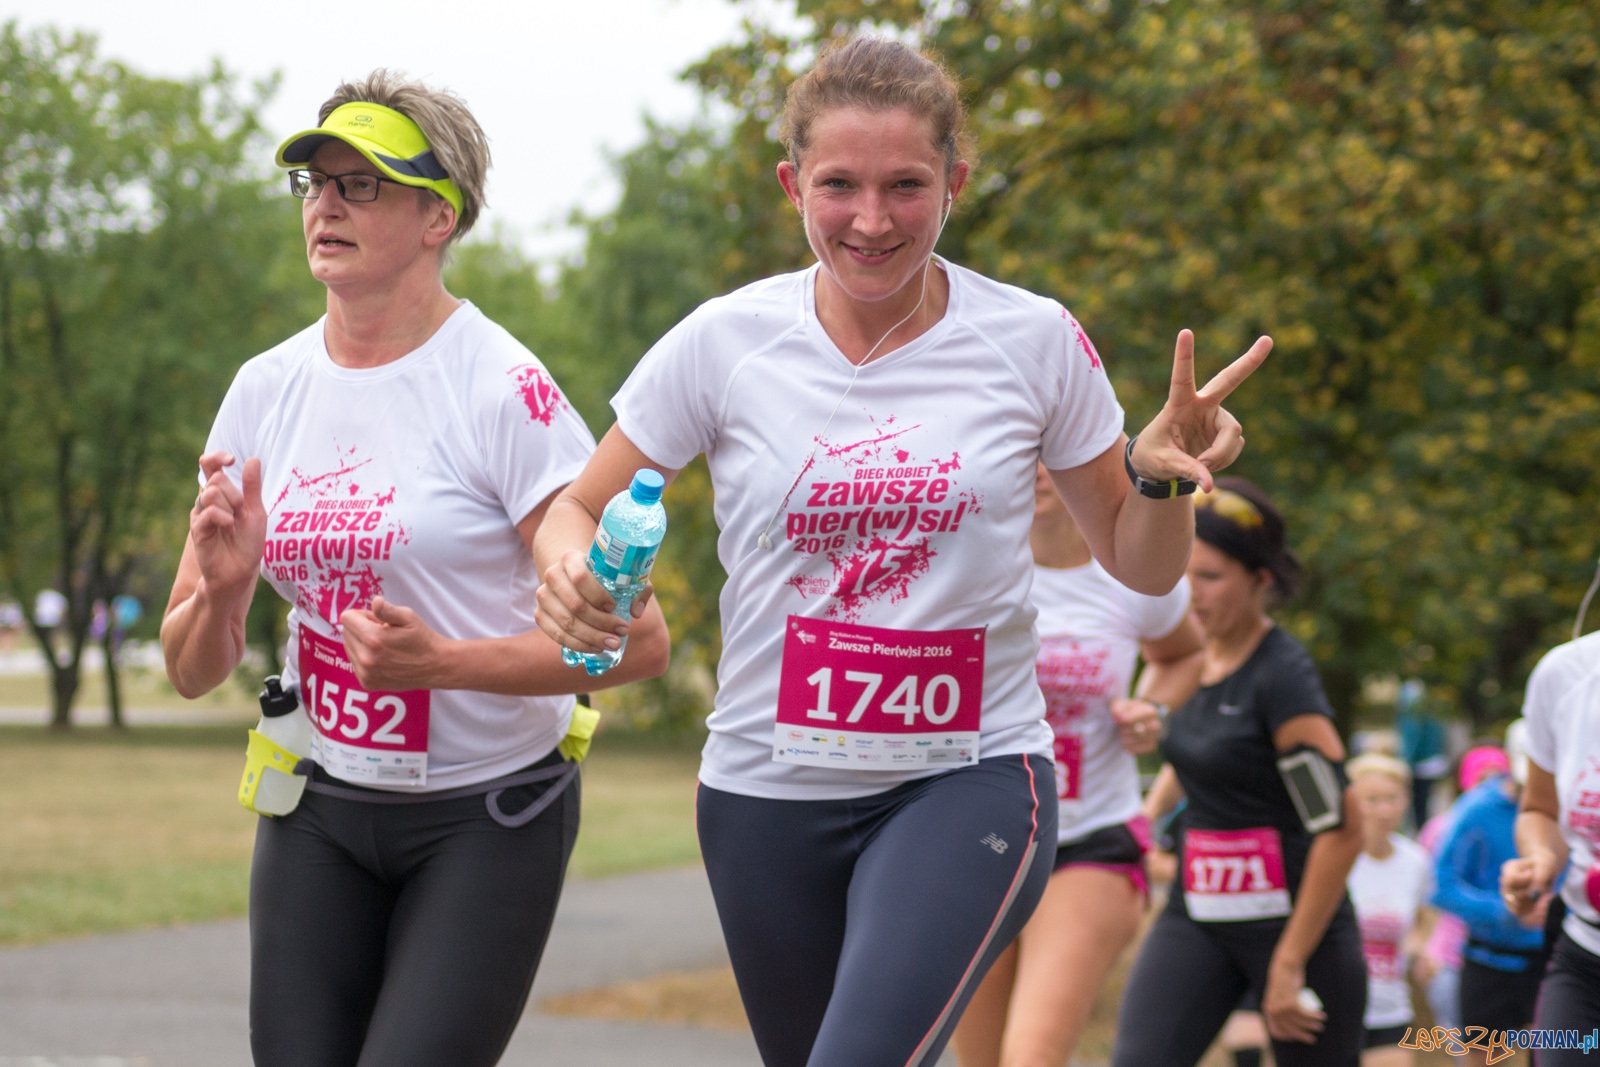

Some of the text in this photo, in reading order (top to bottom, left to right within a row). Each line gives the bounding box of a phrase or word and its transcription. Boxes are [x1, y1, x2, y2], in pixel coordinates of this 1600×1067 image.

[854, 466, 933, 480] BIEG KOBIET
[314, 499, 374, 510] BIEG KOBIET
[806, 478, 949, 508] zawsze
[274, 510, 382, 533] zawsze
[786, 501, 968, 541] pier(w)si!
[793, 534, 847, 555] 2016
[271, 564, 309, 582] 2016
[852, 549, 912, 595] 15
[828, 637, 871, 654] Zawsze
[872, 643, 922, 659] Pier(w)si
[923, 645, 953, 657] 2016
[306, 673, 407, 744] 1552
[806, 667, 961, 726] 1740
[1190, 856, 1274, 892] 1771
